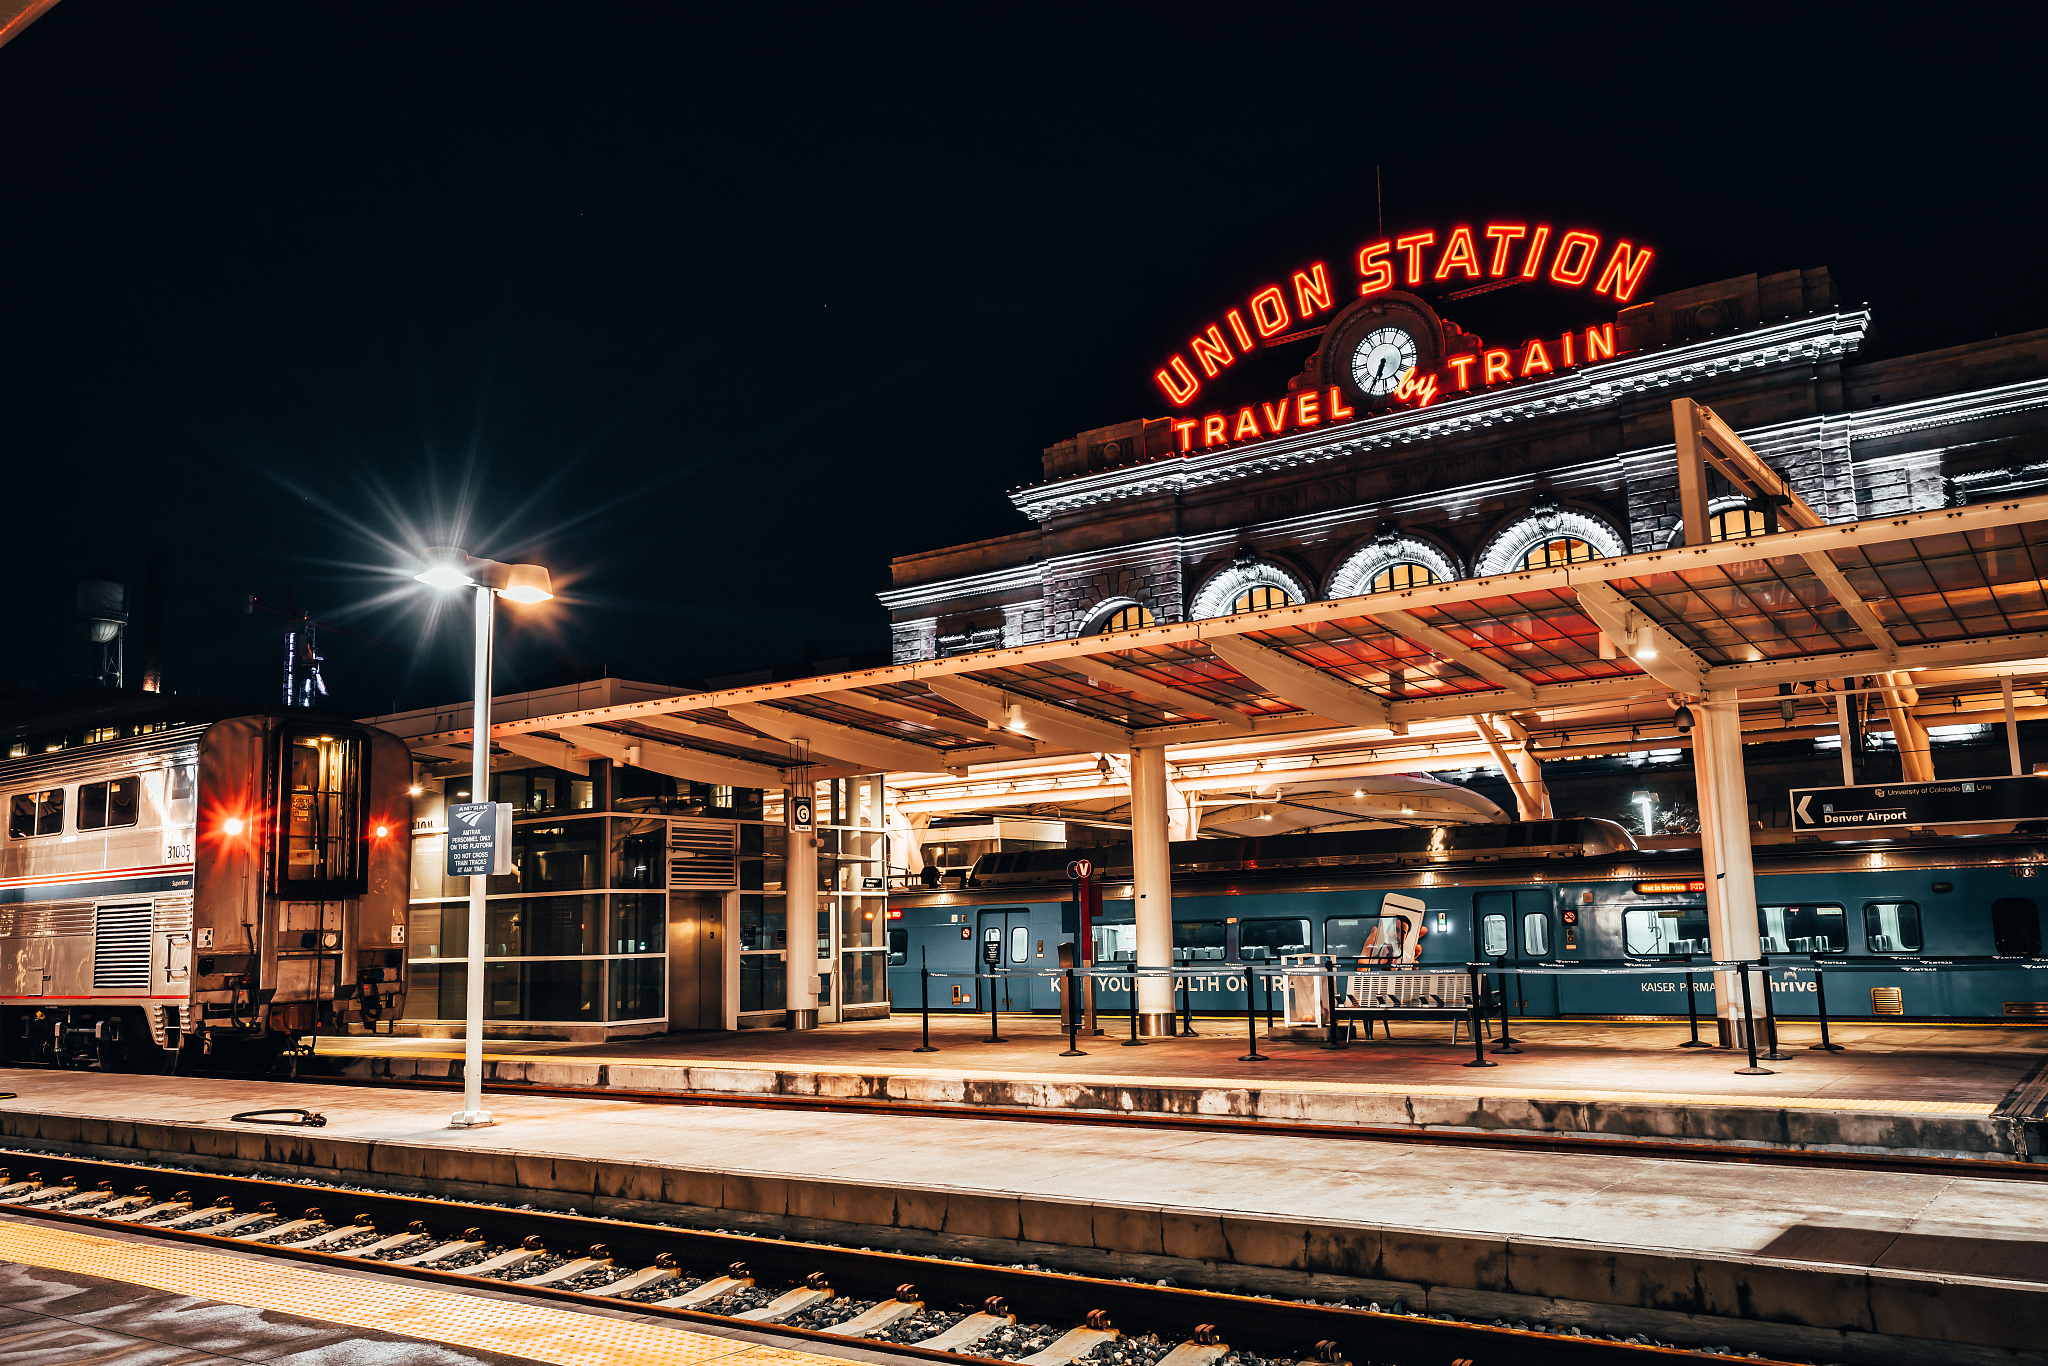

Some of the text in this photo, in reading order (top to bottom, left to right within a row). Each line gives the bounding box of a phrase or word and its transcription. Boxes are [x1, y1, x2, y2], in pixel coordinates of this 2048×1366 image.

[1157, 262, 1332, 404] UNION
[1359, 224, 1652, 302] STATION
[1174, 385, 1354, 453] TRAVEL
[1394, 366, 1438, 407] by
[1448, 322, 1616, 390] TRAIN
[1887, 788, 1920, 796] University
[1929, 786, 1961, 794] Colorado
[1824, 811, 1907, 823] Denver Airport
[469, 841, 493, 849] PLATFORM
[167, 844, 191, 859] 31005
[1079, 863, 1089, 875] V
[2009, 868, 2038, 877] 4003
[1098, 976, 1138, 992] YOU
[1641, 982, 1676, 992] KAISER
[1769, 975, 1818, 993] hrive
